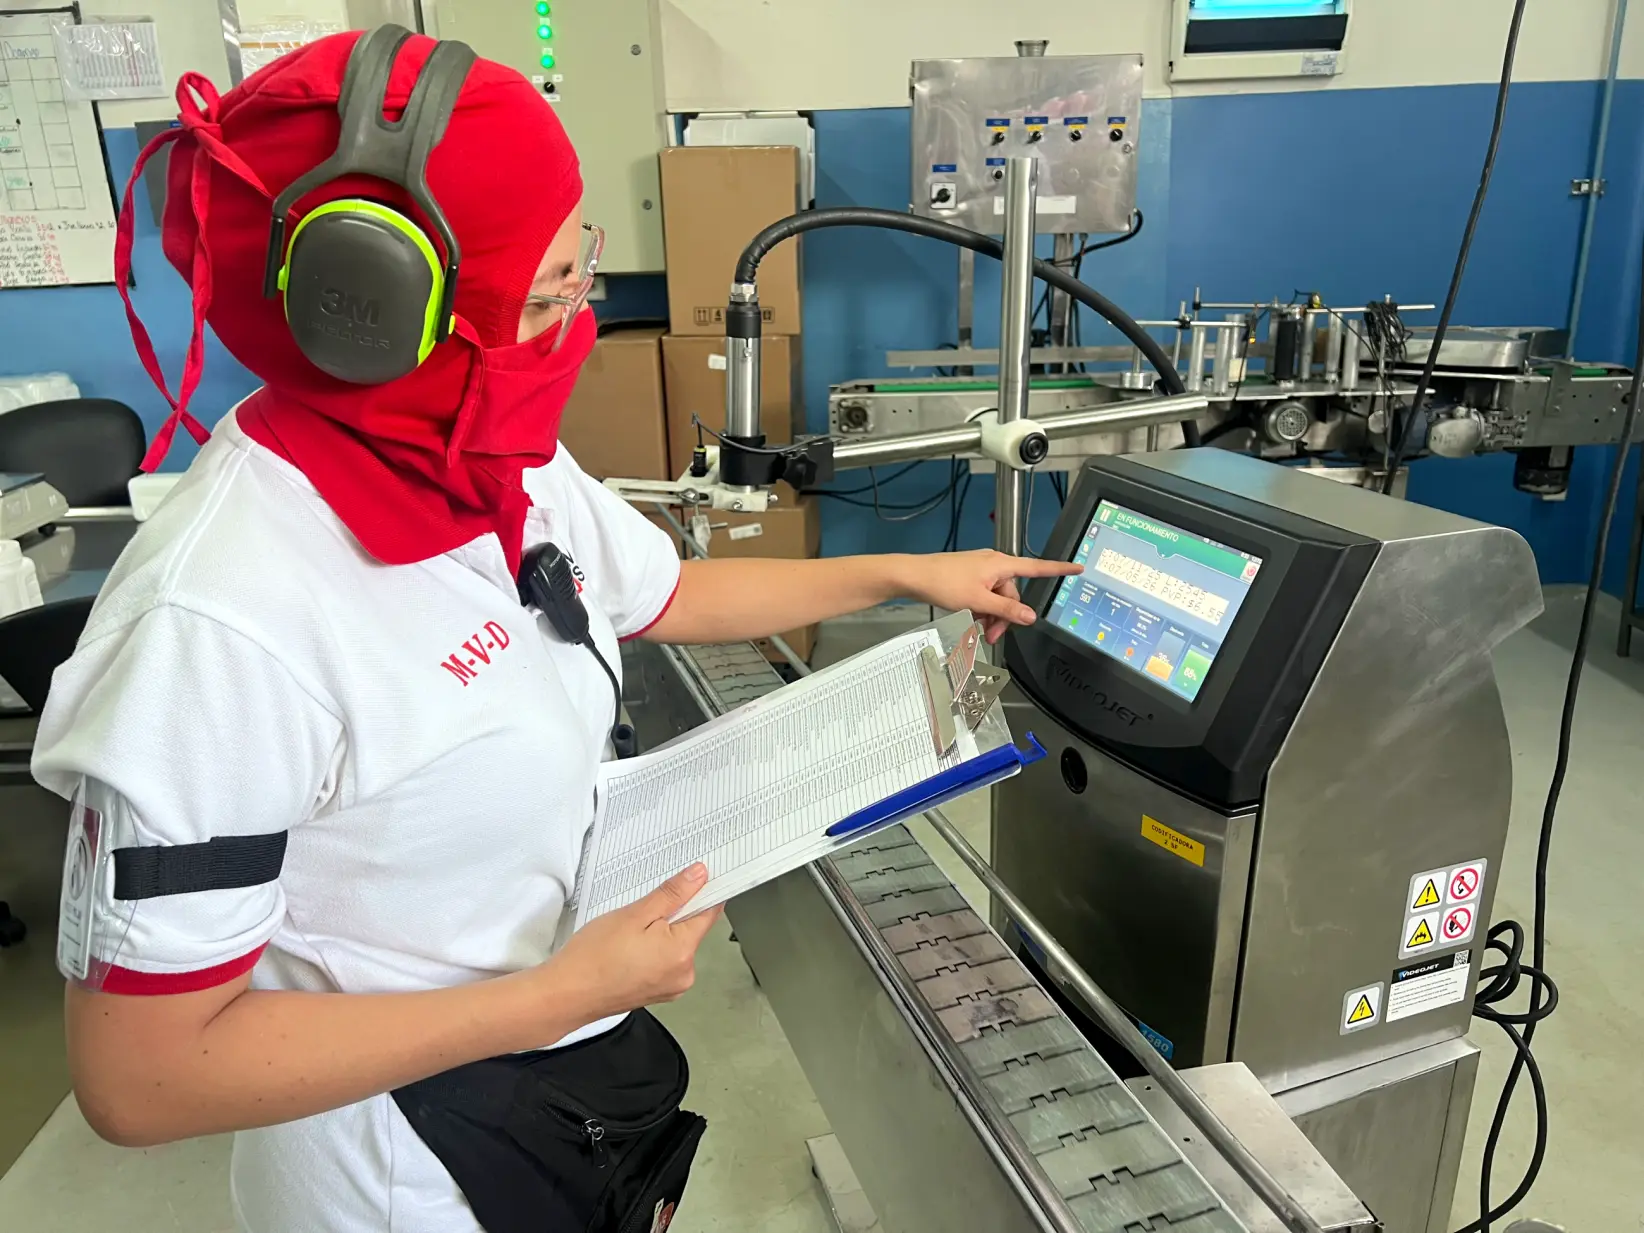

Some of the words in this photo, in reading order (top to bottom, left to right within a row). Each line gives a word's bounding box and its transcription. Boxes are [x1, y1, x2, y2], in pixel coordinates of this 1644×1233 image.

[1116, 512, 1126, 523] EN
[1125, 516, 1179, 542] FUNCIONAMIENTO
[1151, 824, 1194, 850] CODIFICADORA
[1400, 963, 1440, 978] VIDEOJET
